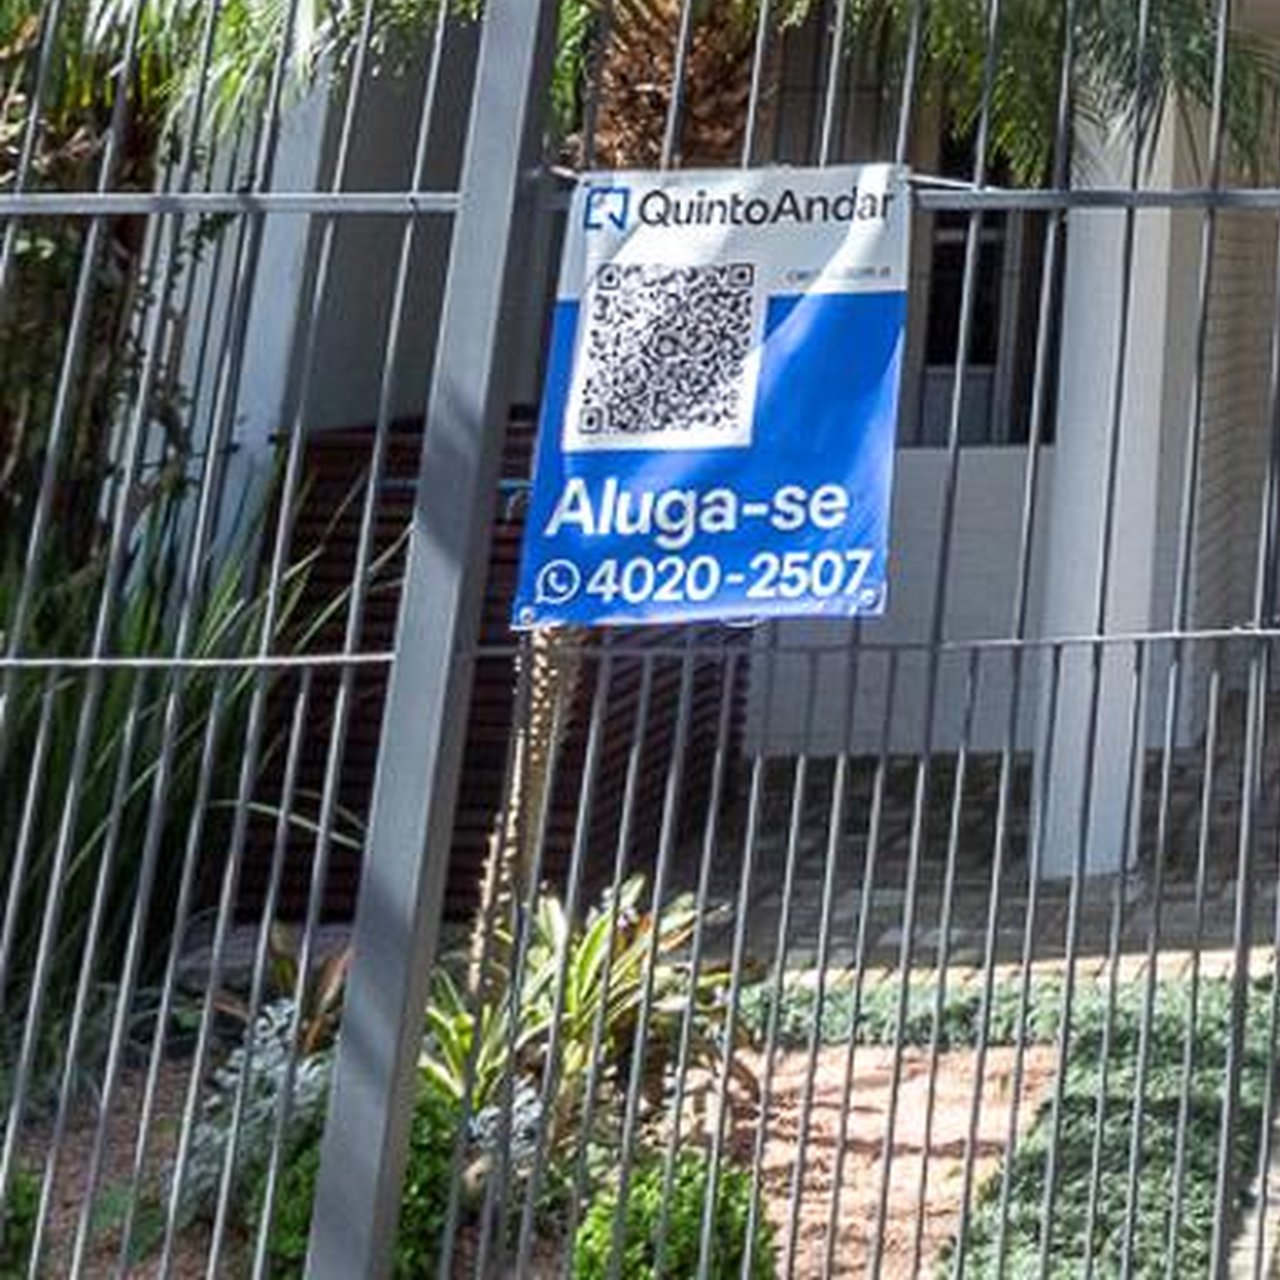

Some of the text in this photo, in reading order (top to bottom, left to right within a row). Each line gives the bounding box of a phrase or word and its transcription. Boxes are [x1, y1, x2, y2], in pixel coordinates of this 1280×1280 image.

[638, 187, 895, 227] QuintoAndar
[544, 478, 850, 549] Aluga-se
[586, 548, 874, 603] 4020-2507
